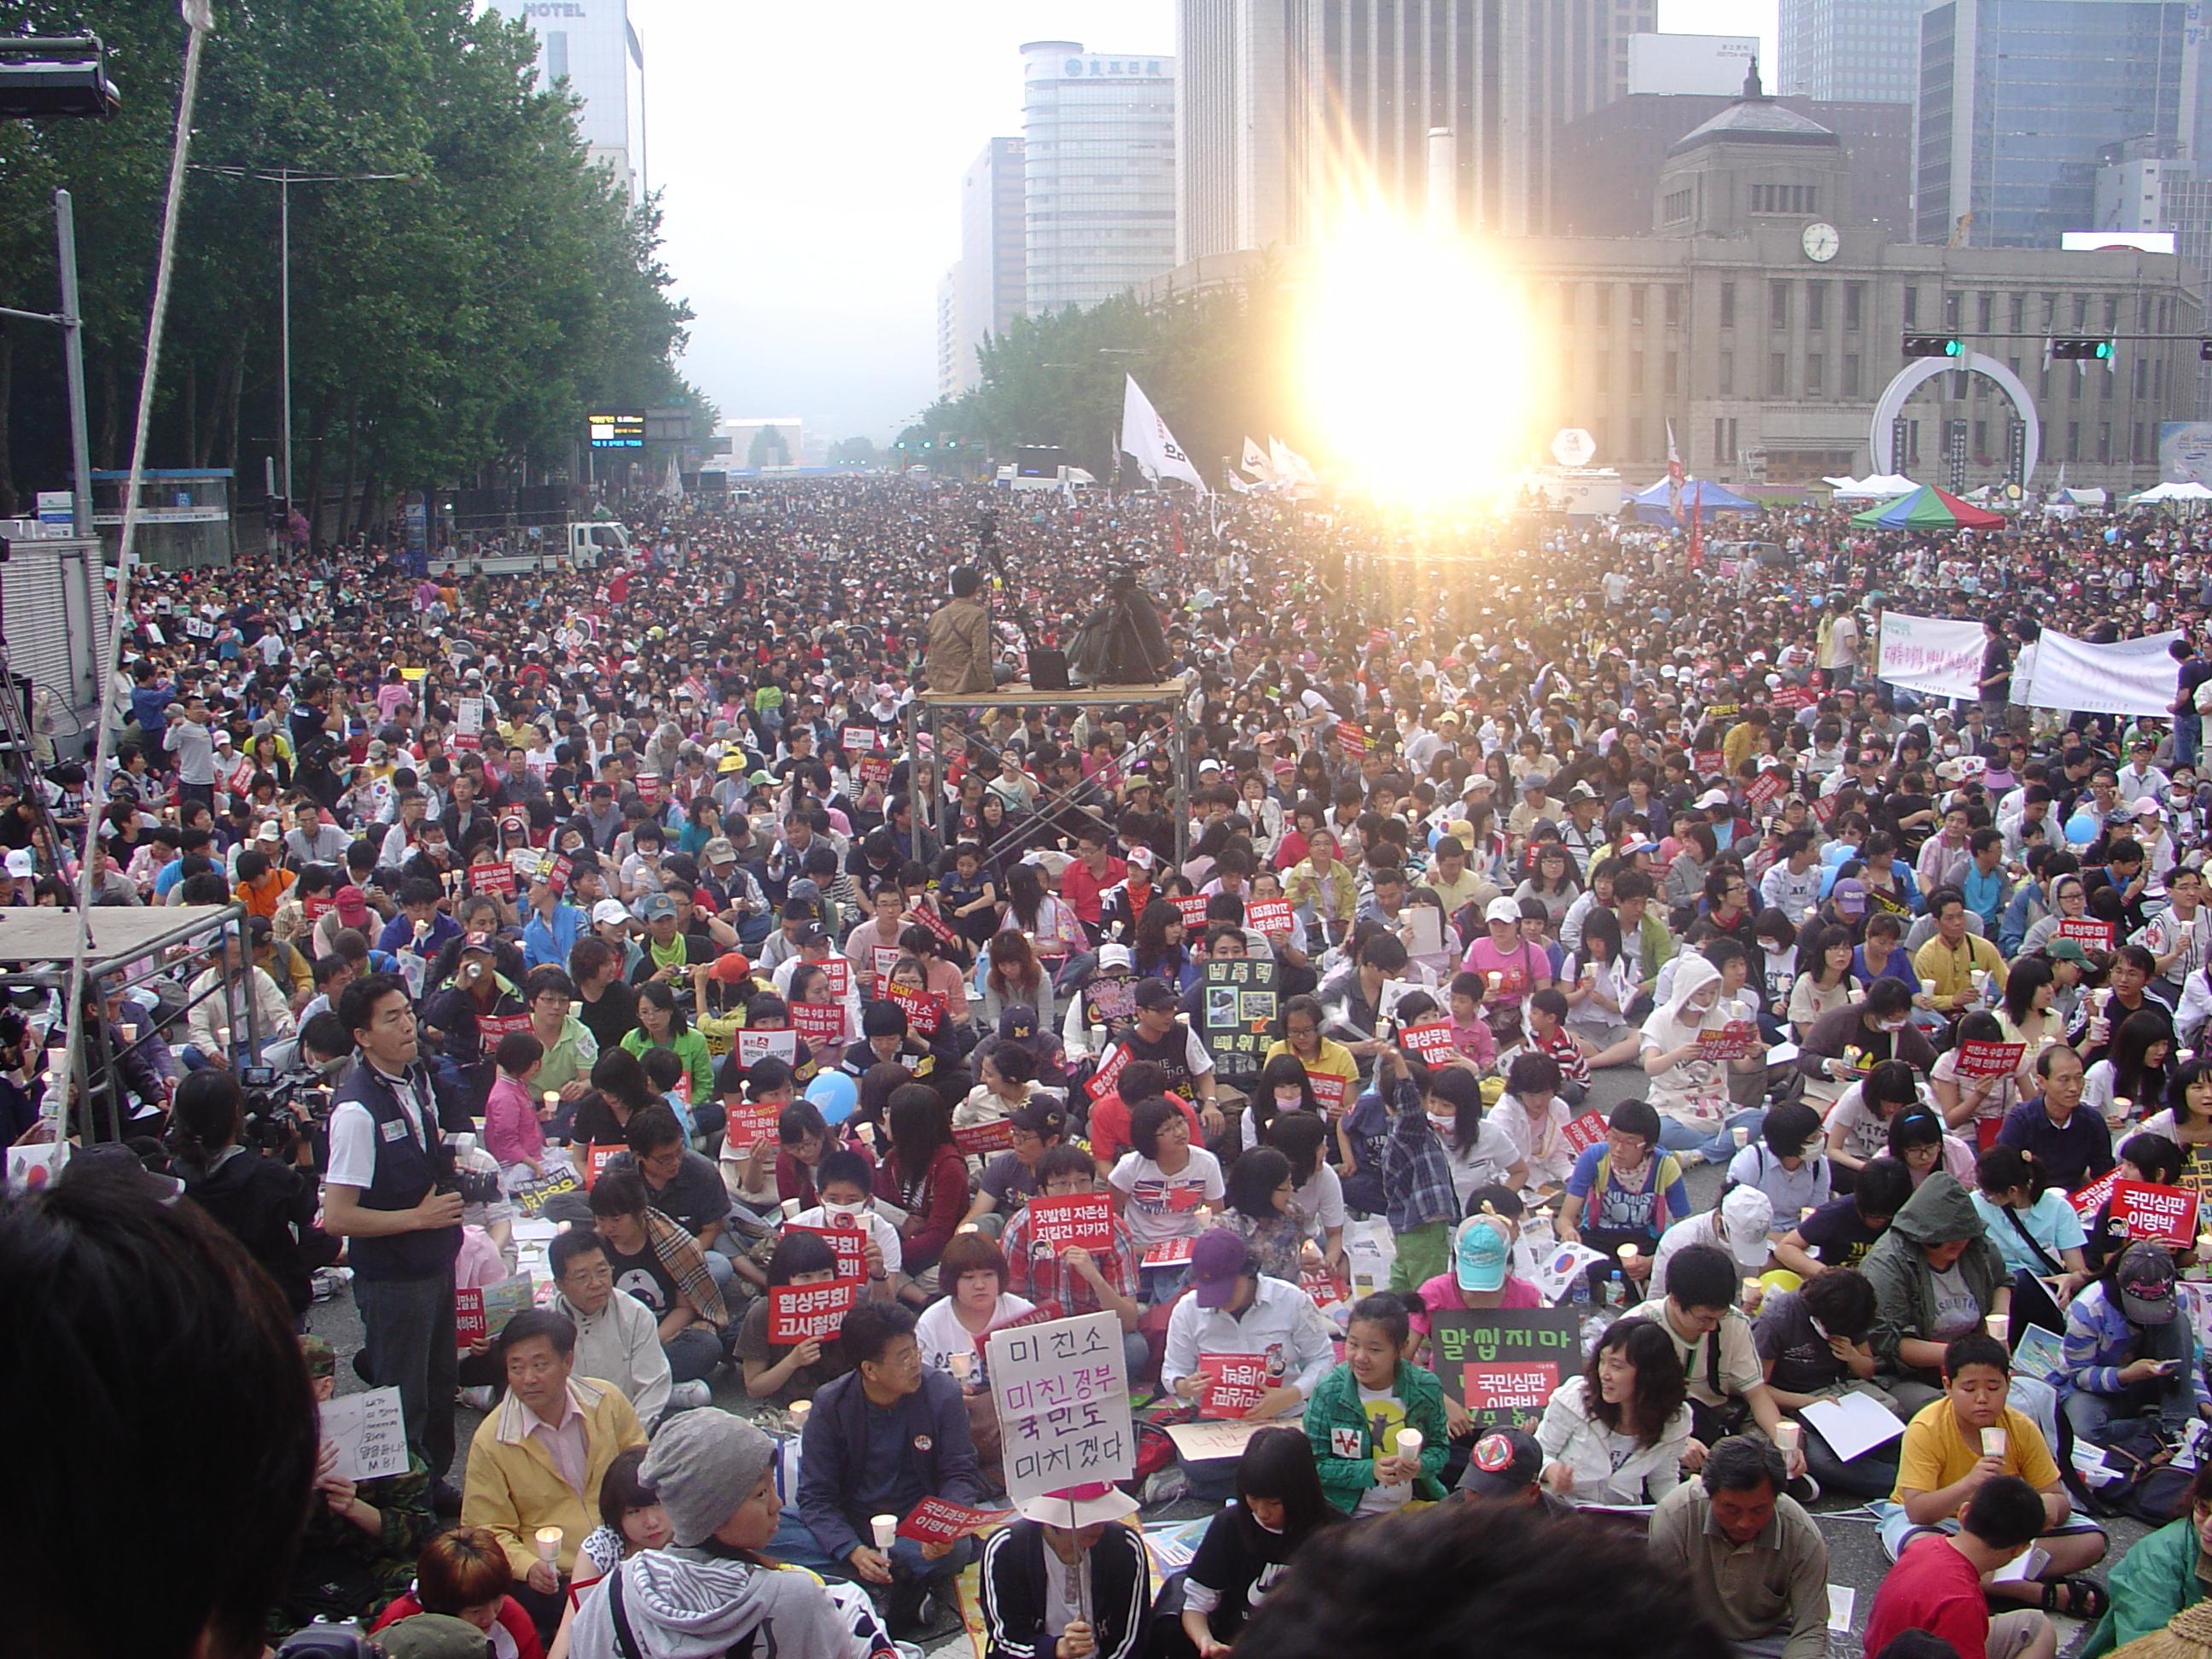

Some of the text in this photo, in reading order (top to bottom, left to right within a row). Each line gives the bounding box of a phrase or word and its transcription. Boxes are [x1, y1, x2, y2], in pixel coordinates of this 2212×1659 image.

[523, 3, 585, 17] HOTEL
[1208, 963, 1272, 983] 비폭력
[1074, 1204, 1109, 1221] 자존심
[2123, 1190, 2186, 1215] 국민심판
[1075, 1222, 1109, 1237] 지키자
[2128, 1210, 2176, 1234] 이명박
[778, 1286, 849, 1314] 협상무효!
[1477, 1372, 1547, 1394] 국민심판
[1018, 1402, 1107, 1441] 국민도
[1016, 1430, 1124, 1479] 미치겠다
[923, 1501, 969, 1523] 국민과의
[915, 1516, 958, 1536] 이명박
